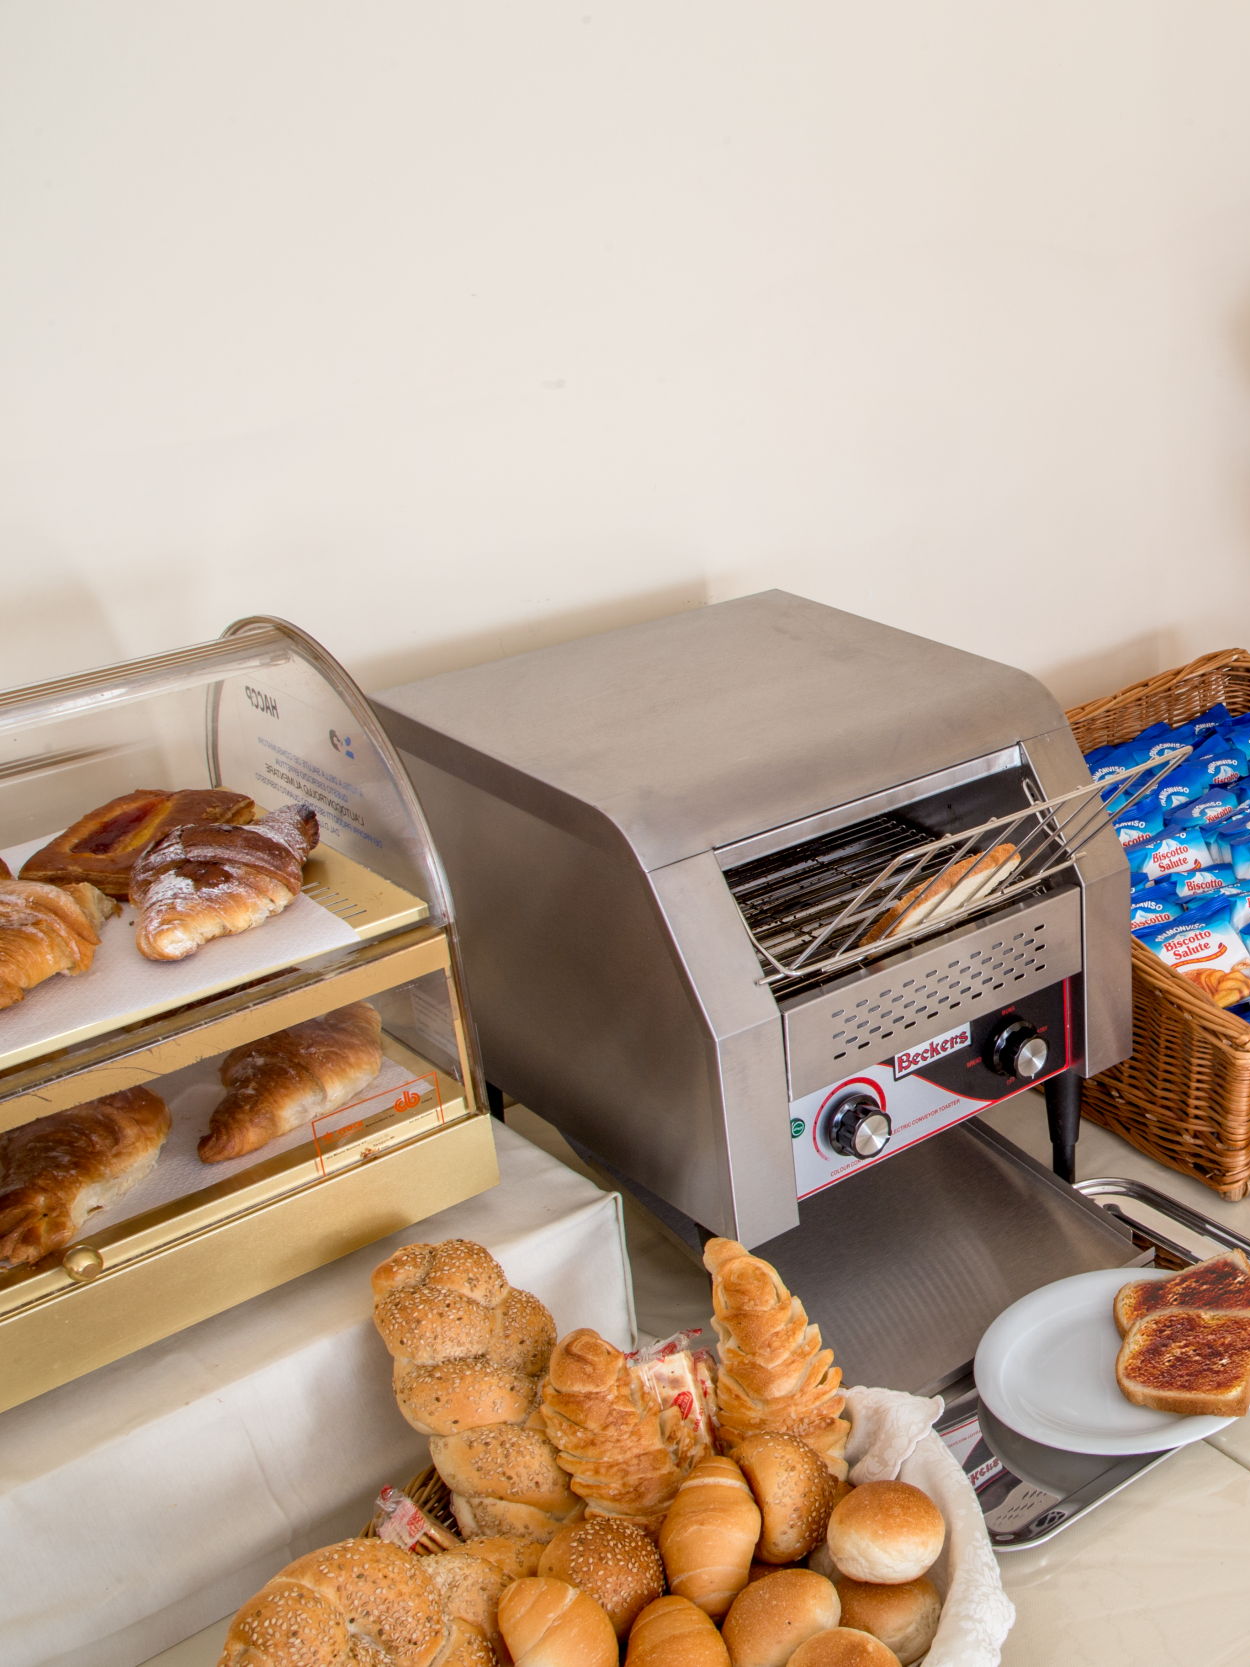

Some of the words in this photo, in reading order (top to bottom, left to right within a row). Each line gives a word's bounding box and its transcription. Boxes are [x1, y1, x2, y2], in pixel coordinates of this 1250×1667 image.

[1152, 845, 1188, 864] Biscotto
[1158, 857, 1188, 872] Salute
[1185, 879, 1223, 892] Biscotto
[1162, 930, 1211, 952] Biscotto
[1173, 942, 1211, 960] Salute
[890, 1123, 912, 1136] LECTRIC
